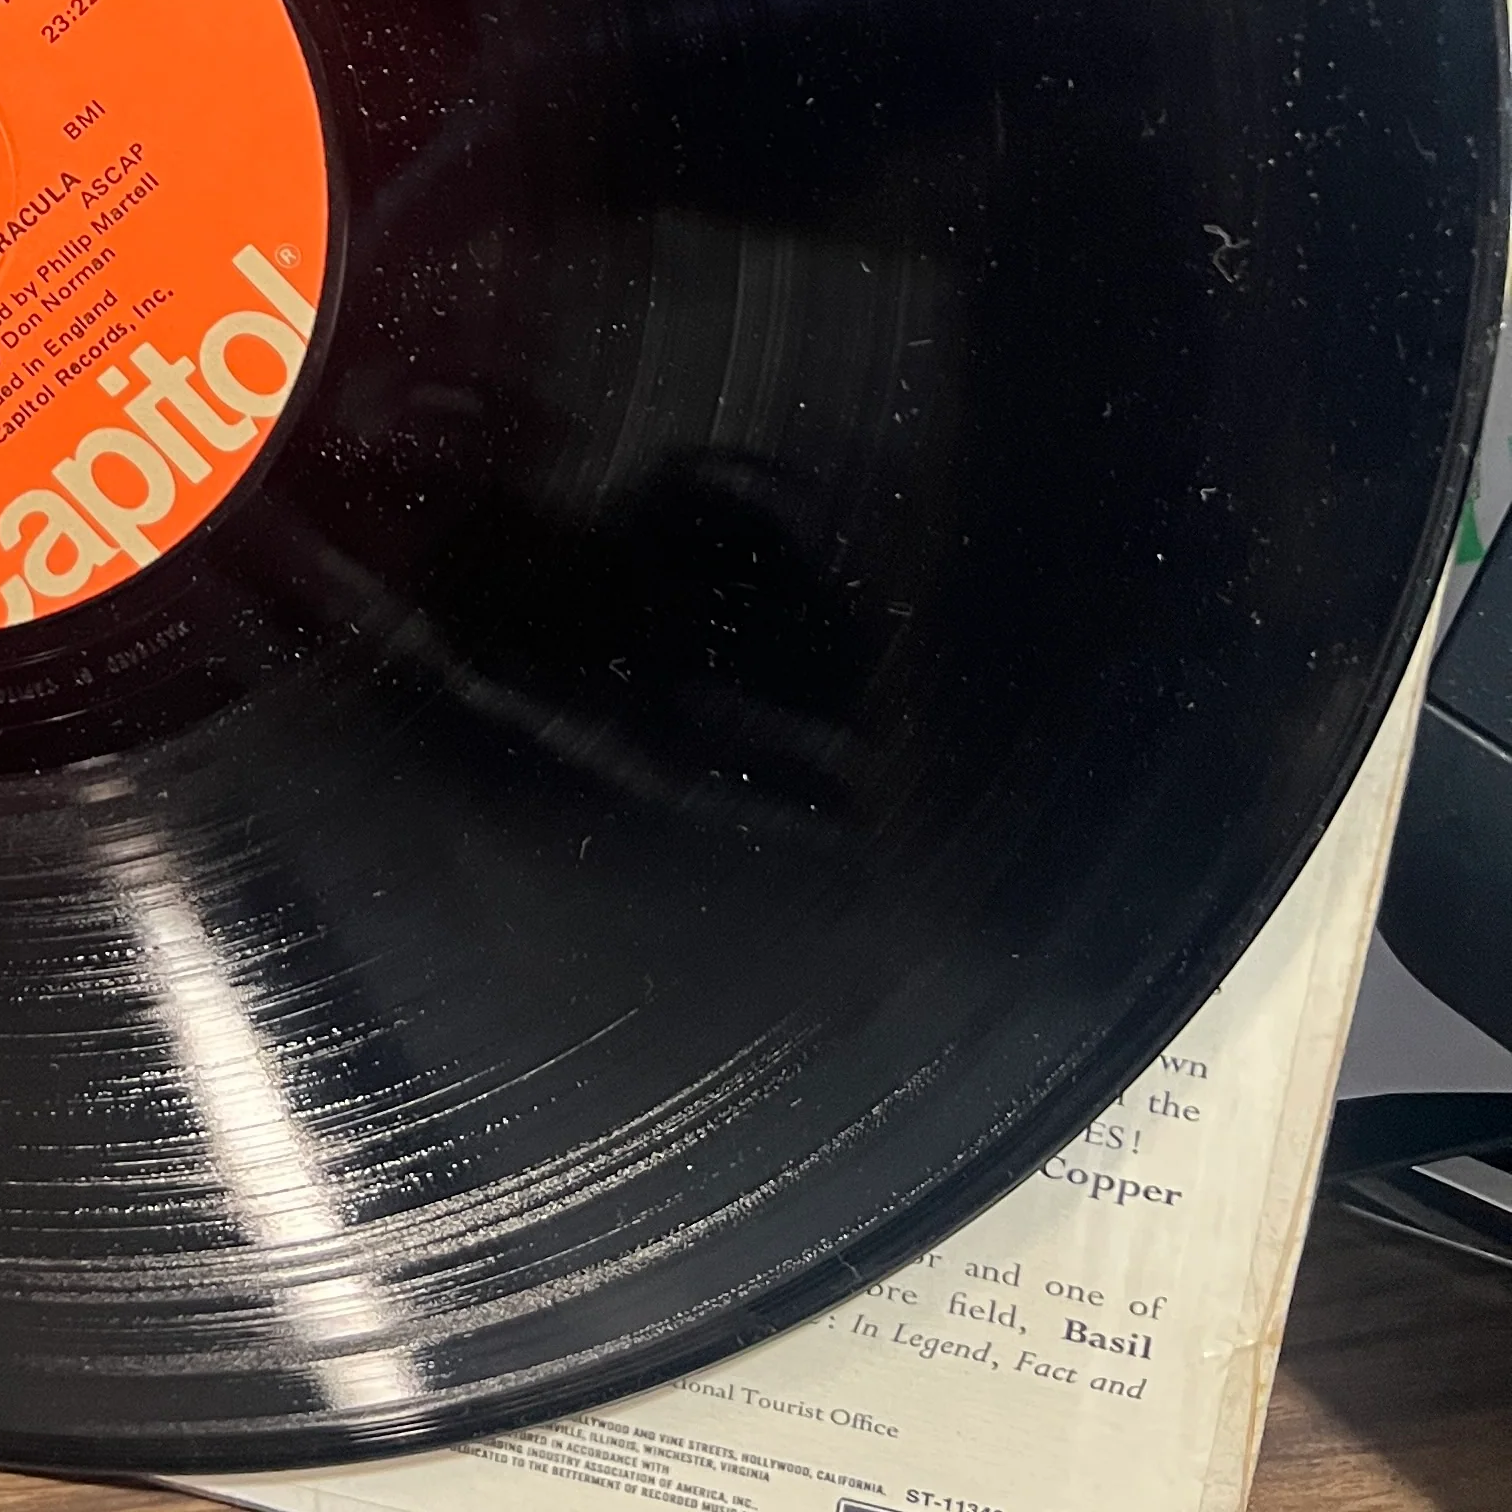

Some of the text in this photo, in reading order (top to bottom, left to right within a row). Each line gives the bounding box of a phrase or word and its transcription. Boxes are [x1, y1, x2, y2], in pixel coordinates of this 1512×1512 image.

[63, 99, 106, 141] BMI
[80, 141, 146, 210] ASCAP
[10, 283, 38, 308] by
[35, 231, 92, 284] Philip
[90, 171, 160, 236] Martell
[0, 312, 43, 349] Don
[40, 246, 117, 313] Norman
[28, 355, 45, 373] in
[43, 290, 119, 357] England
[54, 322, 137, 386] Records,
[131, 290, 175, 320] Inc.
[1148, 1091, 1201, 1122] the
[1040, 1155, 1183, 1207] Copper
[964, 1259, 1168, 1321] and one of
[850, 1313, 1148, 1401] In Legend, Fact and
[948, 1291, 1153, 1361] field, Basil
[633, 1427, 656, 1441] AND
[659, 1432, 685, 1448] VINE
[741, 1386, 899, 1439] Tourist Office
